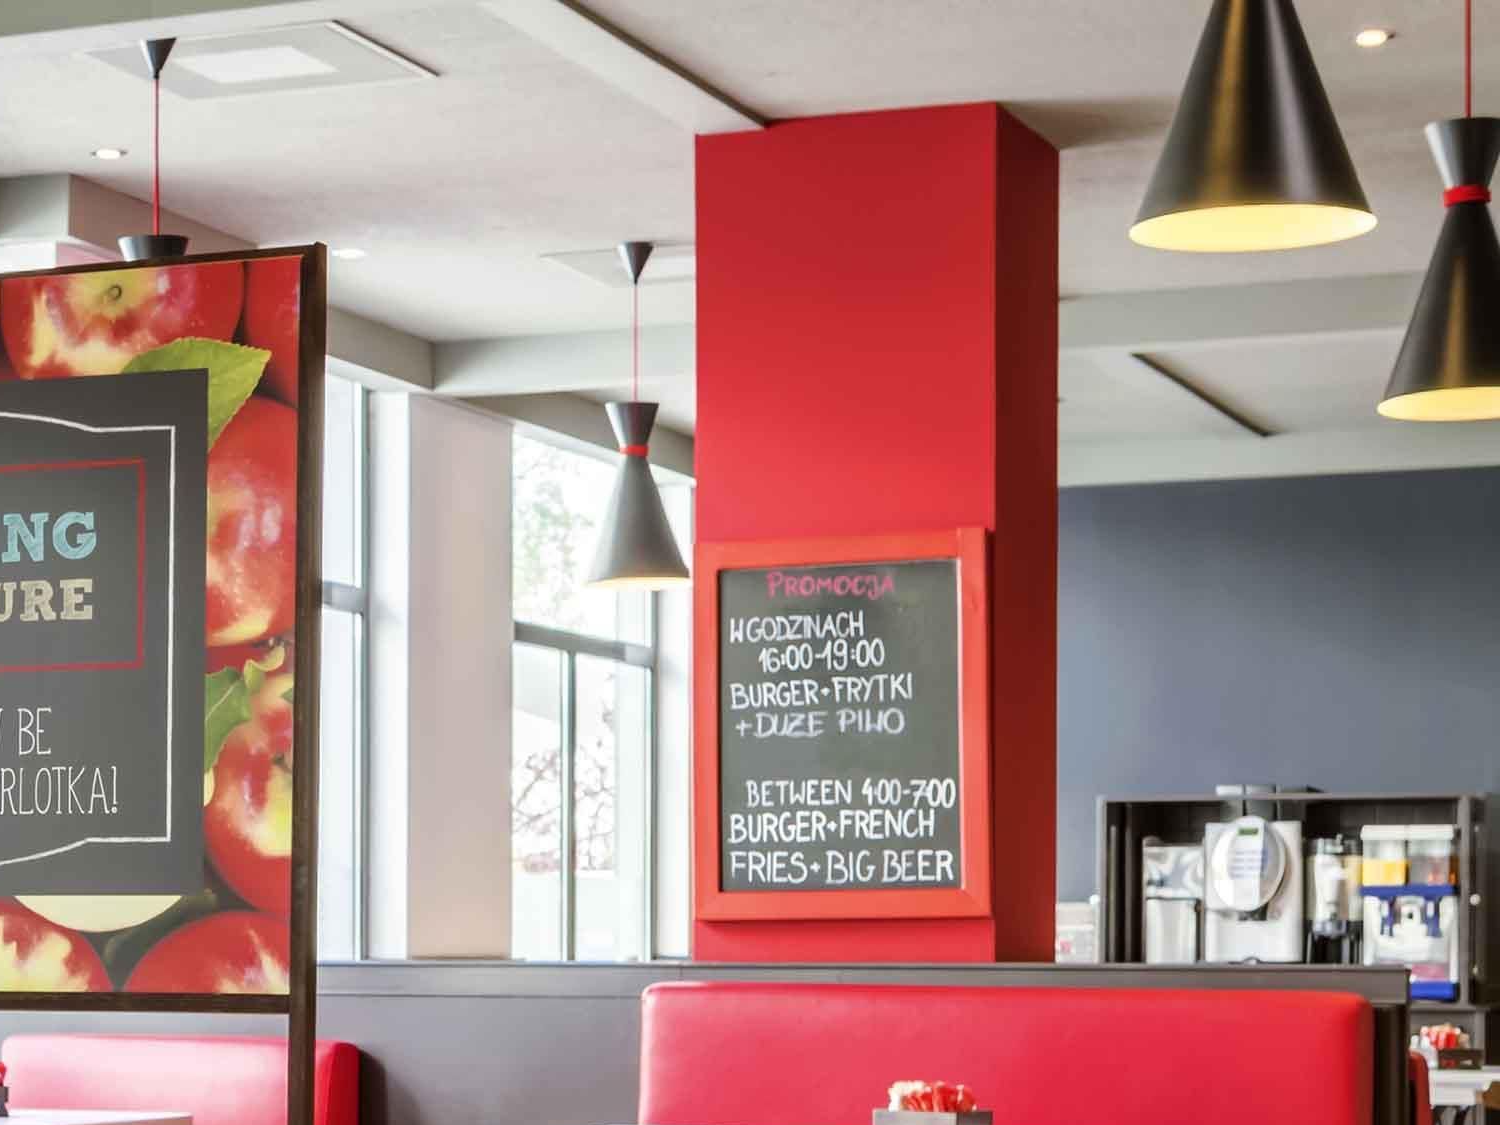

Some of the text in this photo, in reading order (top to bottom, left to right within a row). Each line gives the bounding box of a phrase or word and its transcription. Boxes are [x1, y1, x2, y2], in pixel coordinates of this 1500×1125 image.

[17, 707, 52, 756] BE
[836, 707, 906, 735] PIWO
[746, 780, 852, 808] BETWEEN
[825, 850, 877, 884] BIG
[882, 850, 955, 884] BEER
